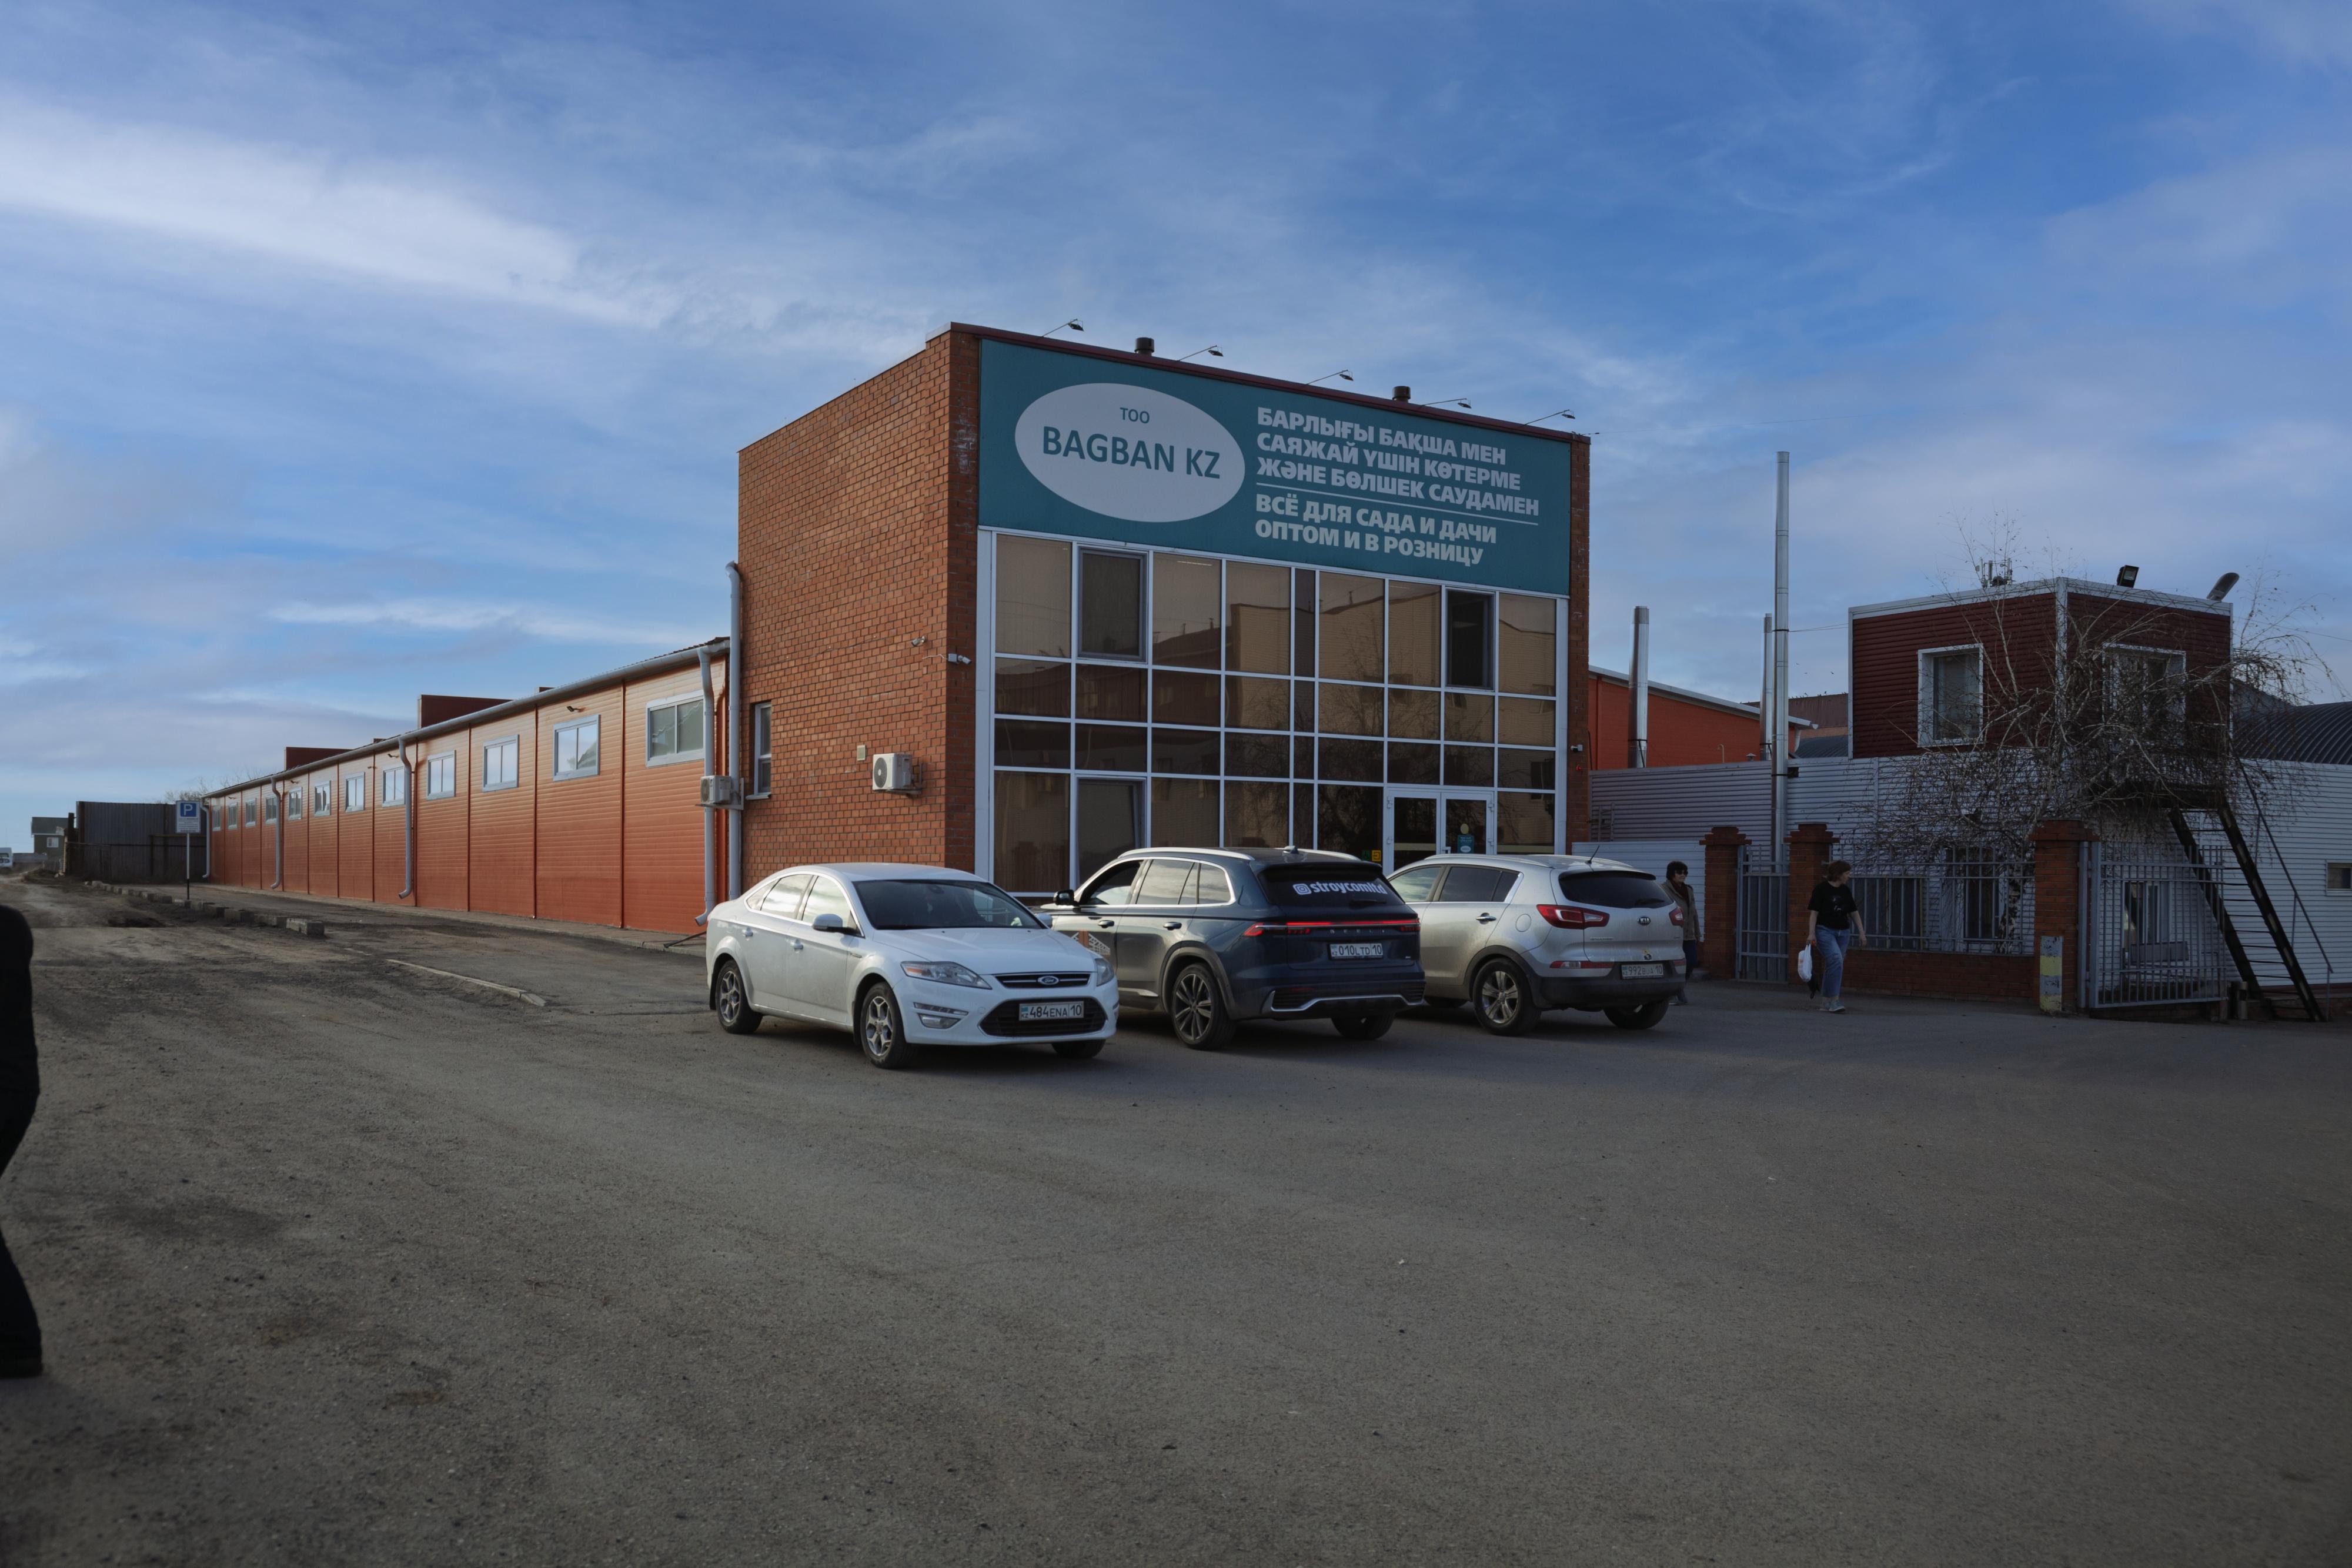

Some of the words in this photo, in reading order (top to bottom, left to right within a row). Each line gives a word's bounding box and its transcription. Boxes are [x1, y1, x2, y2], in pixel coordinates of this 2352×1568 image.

[1043, 426, 1174, 473] BAGBAN
[1186, 448, 1221, 479] KZ
[1258, 407, 1374, 443] БАРЛЫҒЫ
[1379, 427, 1457, 457] БАҚША
[1462, 442, 1506, 465] МЕН
[1257, 432, 1358, 464] САЯЖАЙ
[1363, 449, 1419, 474] ҮШІН
[1425, 459, 1521, 490] КӨТЕРМЕ
[1257, 457, 1326, 484] ЖӘНЕ
[1331, 468, 1424, 499] БӨЛШЕК
[1429, 484, 1539, 516] САУДАМЕН
[1256, 493, 1298, 517] ВСЁ
[1303, 500, 1351, 524] ДЛЯ
[1356, 508, 1416, 534] САДА
[1420, 517, 1435, 535] И
[1439, 520, 1496, 544] ДАЧИ
[1255, 519, 1339, 547] ОПТОМ
[1344, 530, 1360, 549] И
[1365, 533, 1379, 551] В
[1384, 536, 1484, 567] РОЗНИЦУ
[183, 804, 193, 816] P
[1309, 881, 1388, 894] stroycomltd
[1338, 945, 1370, 955] 010LTD
[1372, 944, 1382, 955] 10
[1655, 965, 1663, 975] 10
[1030, 1005, 1068, 1018] 484ENA
[1070, 1004, 1082, 1017] 10
